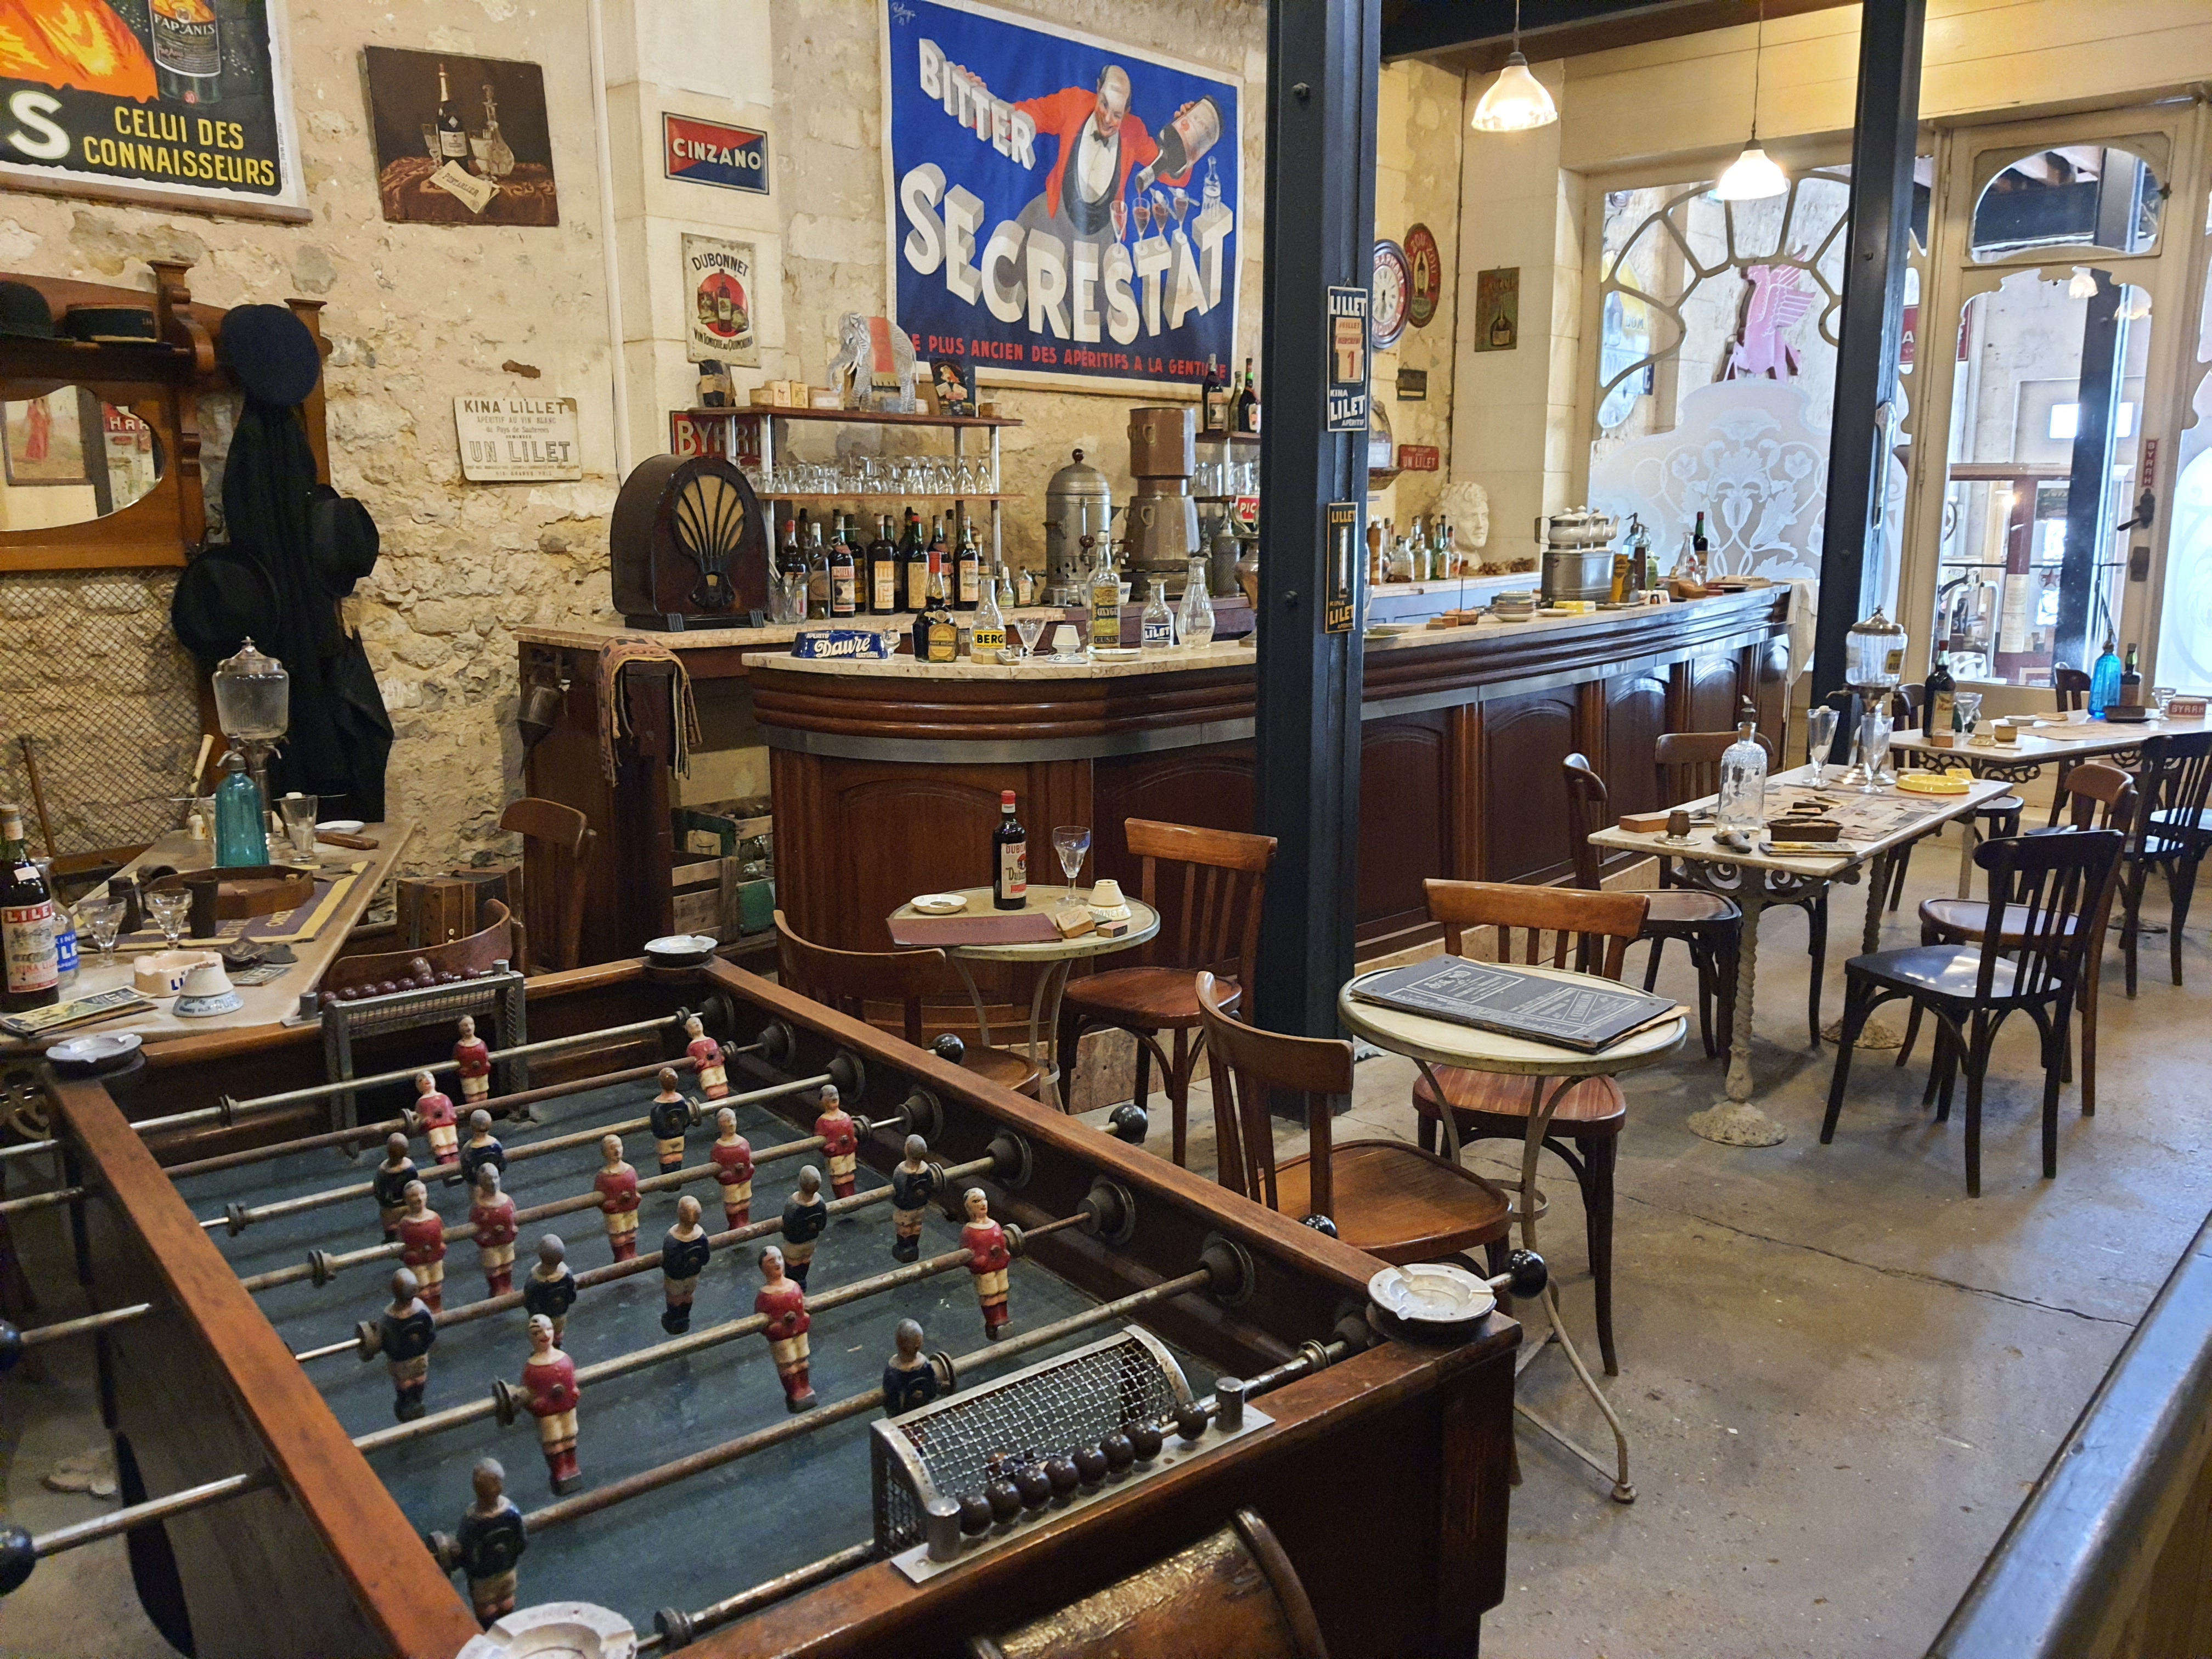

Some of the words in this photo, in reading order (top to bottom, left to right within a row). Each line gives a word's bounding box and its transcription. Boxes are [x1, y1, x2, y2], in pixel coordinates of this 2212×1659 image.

[919, 38, 1036, 170] BITTER
[114, 106, 187, 143] CELUI
[198, 118, 244, 150] DES
[83, 136, 274, 187] CONNAISSEURS
[672, 138, 761, 170] CINZANO
[692, 252, 749, 276] DUBONNET
[900, 162, 1234, 346] SECRESTAT
[1330, 295, 1366, 317] LILLET
[929, 335, 965, 355] PLUS
[970, 340, 1024, 361] ANCIEN
[1031, 346, 1058, 364] DES
[1133, 356, 1143, 371] A
[1148, 358, 1163, 373] LA
[1169, 358, 1226, 379] GENTIE
[1347, 351, 1355, 378] 1
[464, 400, 501, 413] KINA
[510, 401, 565, 414] LILLET
[1330, 395, 1365, 421] LILET
[496, 426, 510, 435] Pays
[469, 441, 497, 462] UN
[507, 441, 571, 462] LILET
[1331, 510, 1356, 523] LILLET
[2171, 704, 2205, 714] BYRRH
[7, 904, 52, 923] LILE
